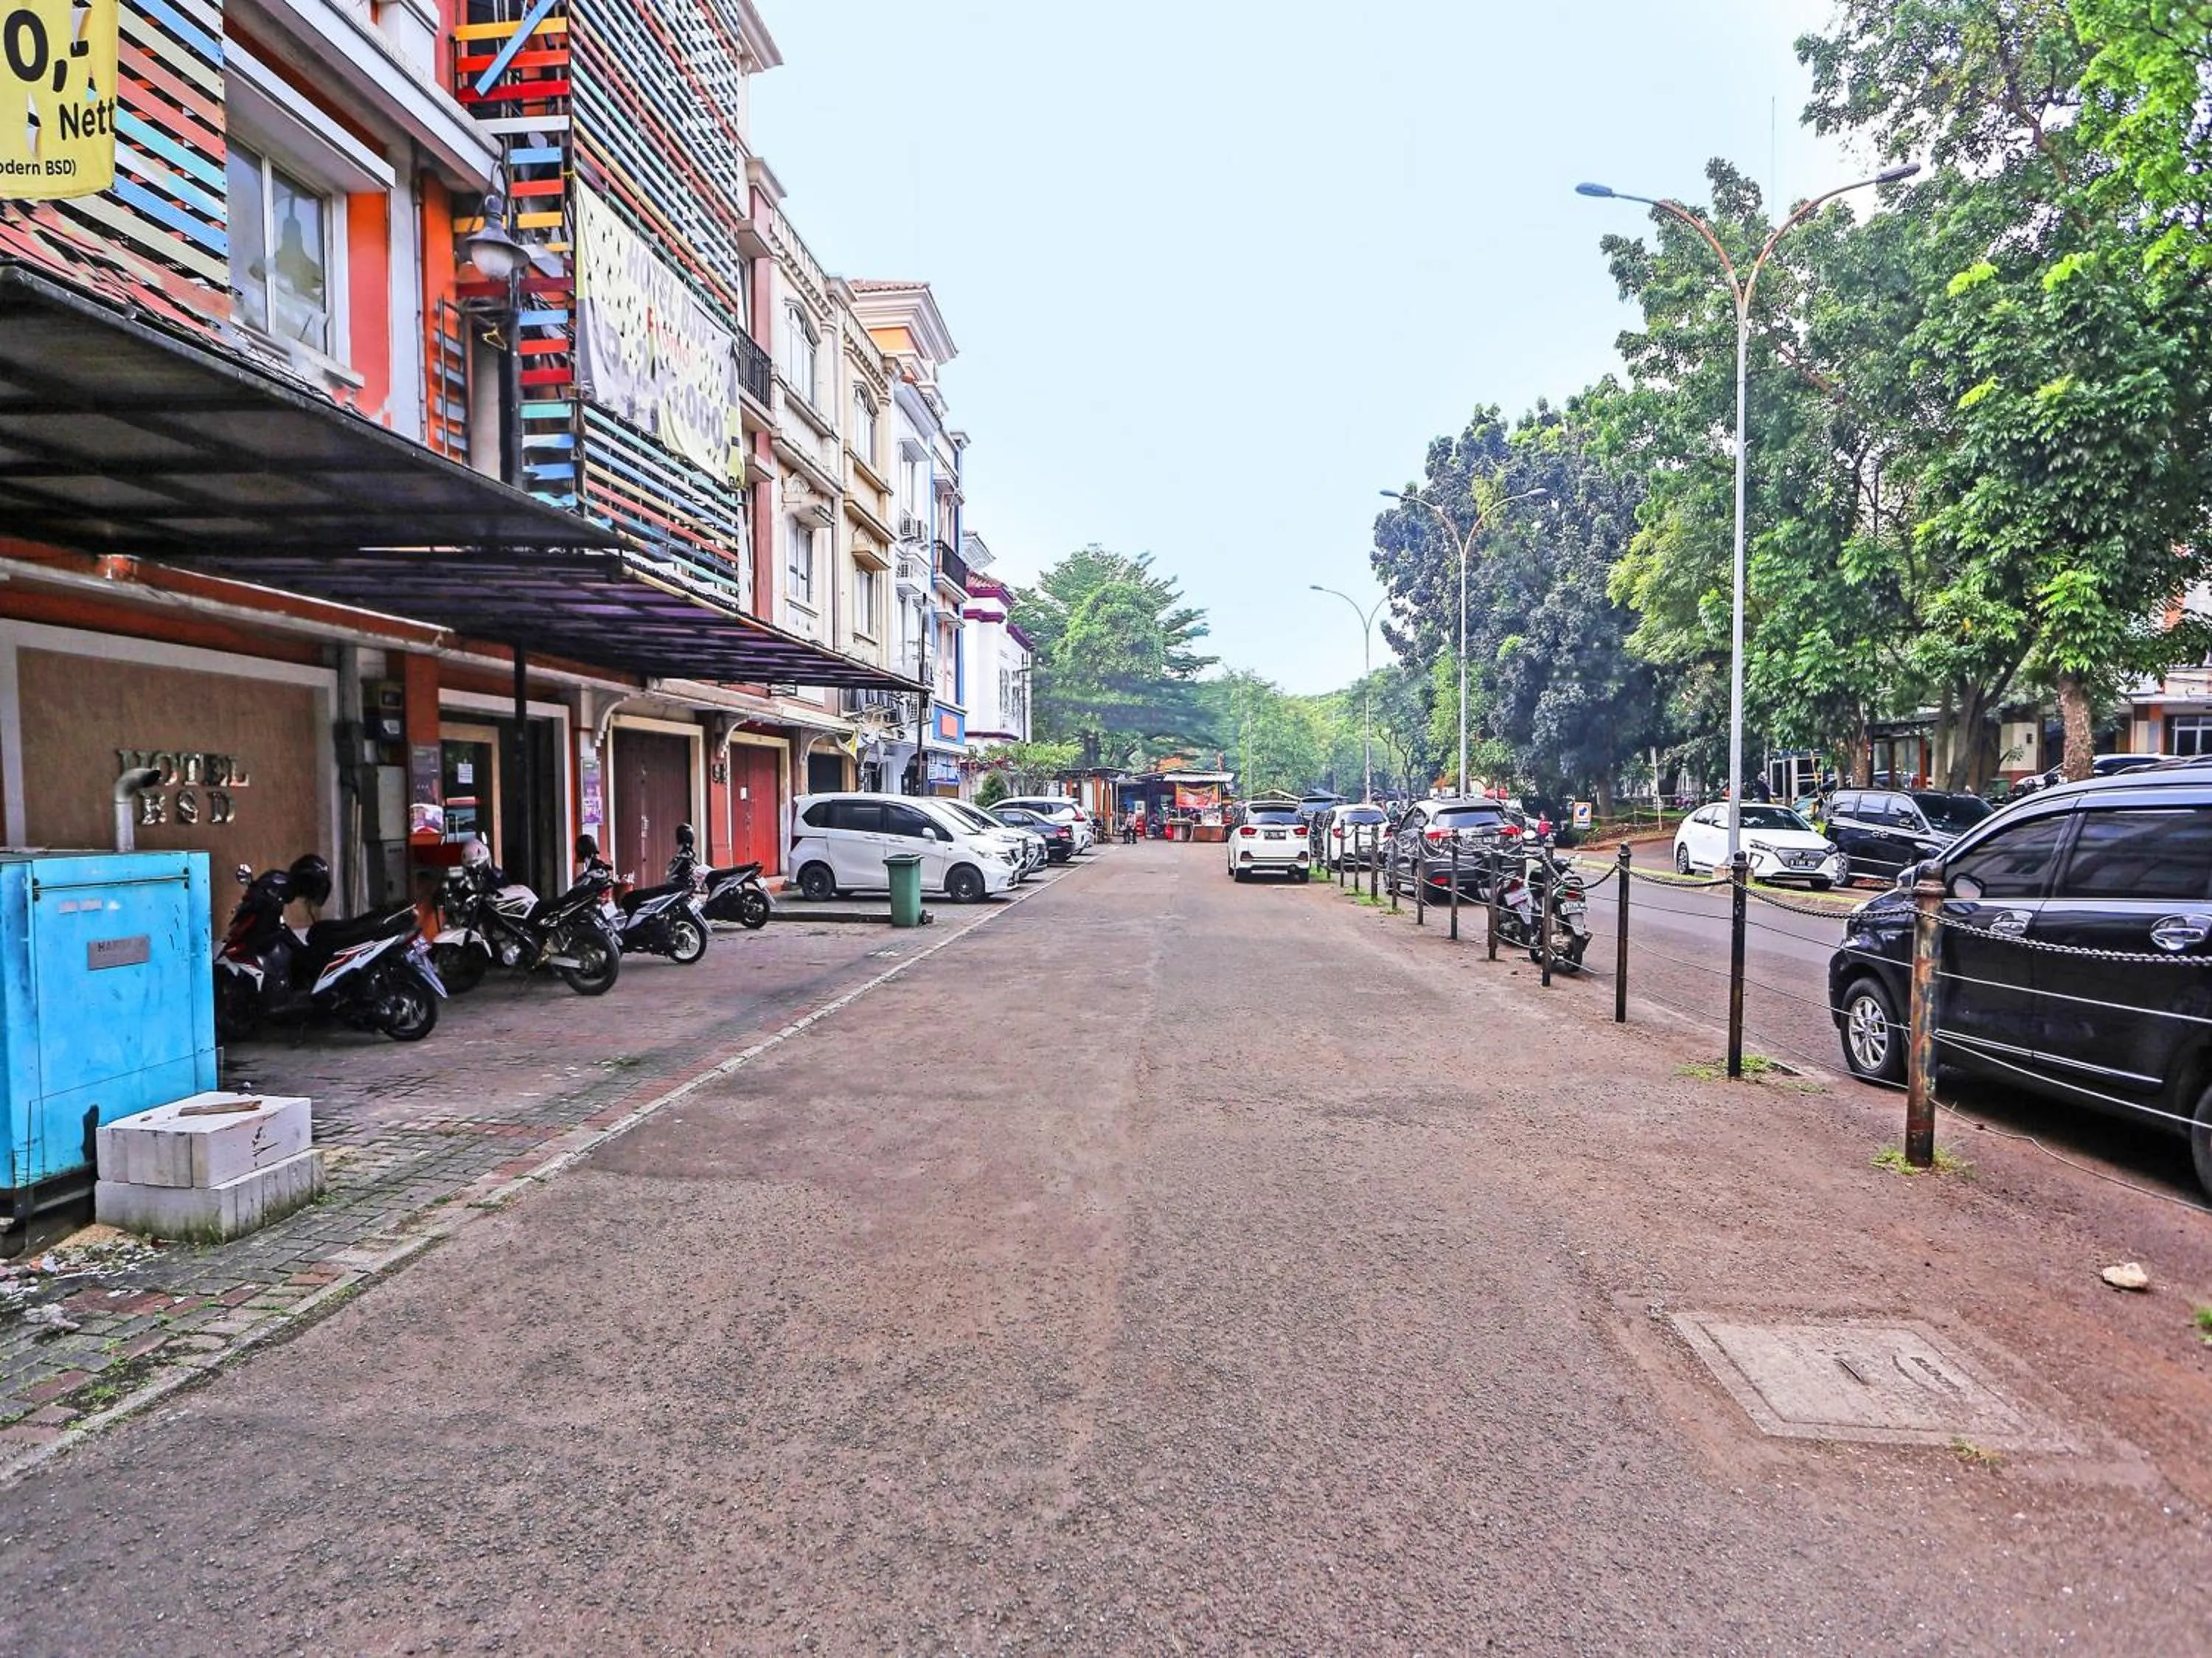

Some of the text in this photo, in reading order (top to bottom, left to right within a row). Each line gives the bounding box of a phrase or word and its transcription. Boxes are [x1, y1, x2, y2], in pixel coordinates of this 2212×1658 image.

[45, 159, 77, 177] BSD)
[116, 749, 250, 788] HOTEL
[137, 788, 237, 826] BSD
